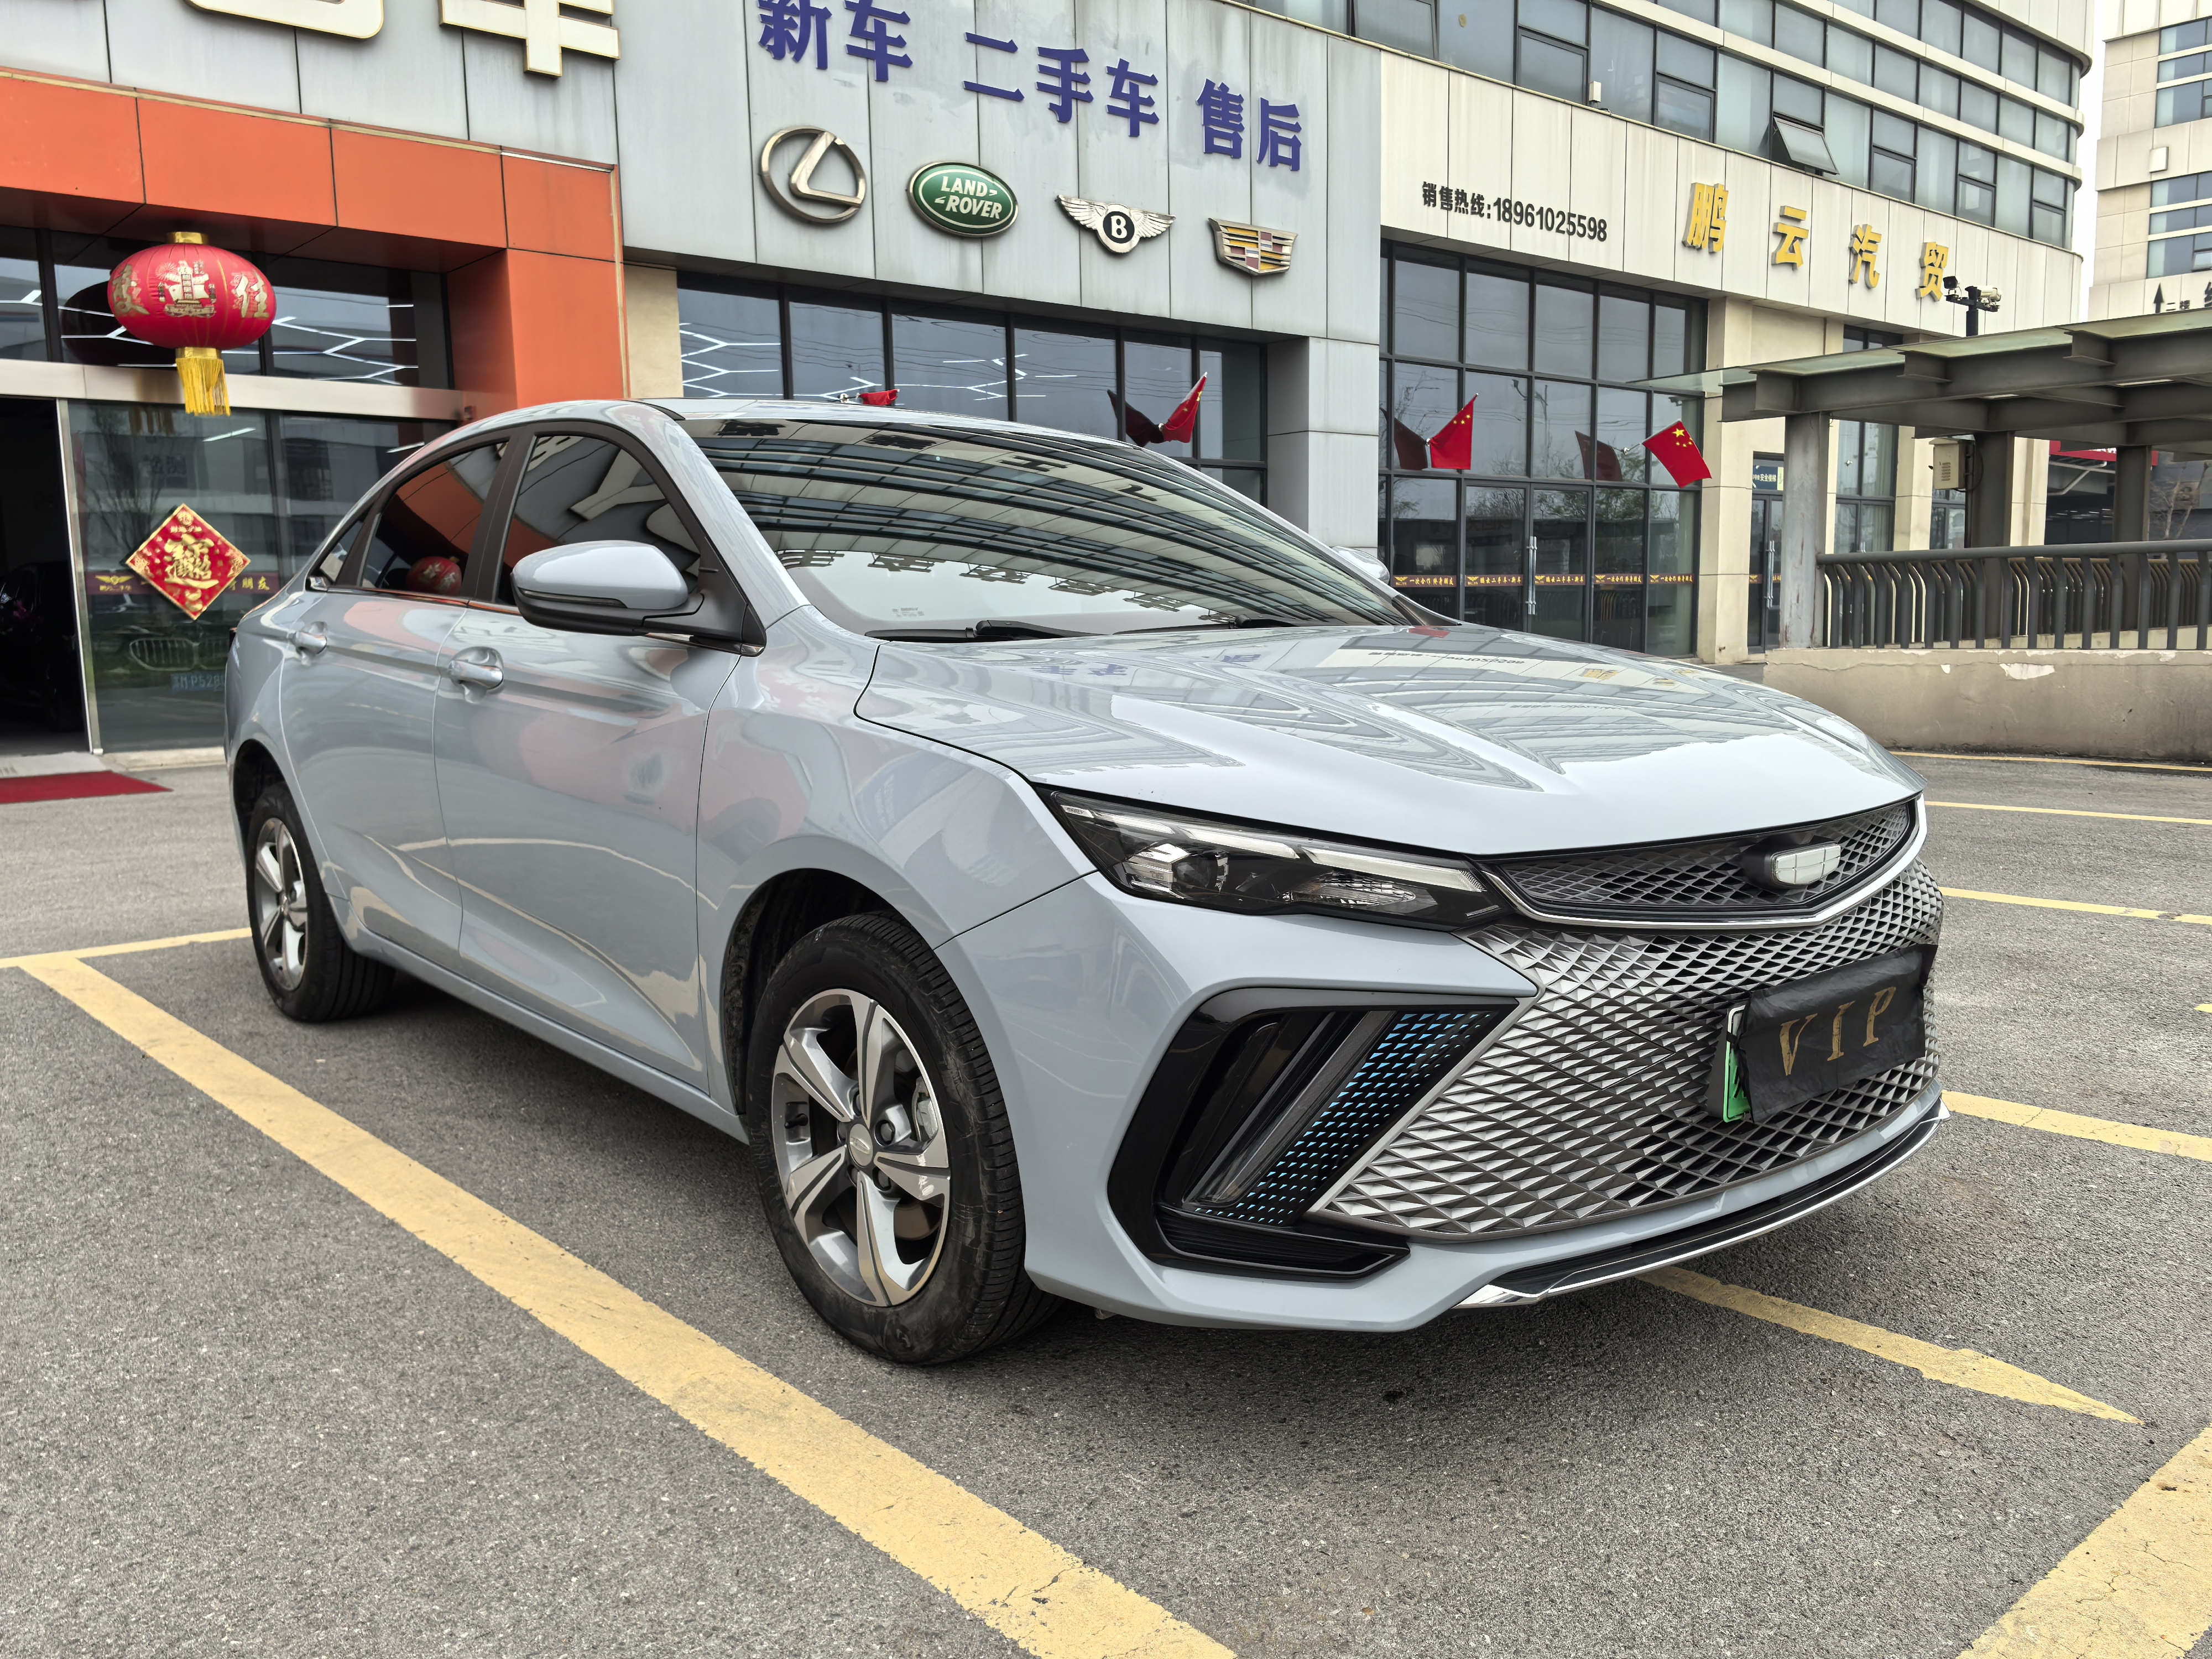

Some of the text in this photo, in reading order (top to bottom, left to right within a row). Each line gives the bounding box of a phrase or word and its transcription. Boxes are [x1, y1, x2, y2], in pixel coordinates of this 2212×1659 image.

[963, 32, 1160, 138] 二手车
[1196, 78, 1302, 171] 售后
[941, 176, 988, 197] LAND
[945, 195, 1003, 220] ROVER
[1422, 181, 1608, 242] 销售热线:18961025598
[1110, 215, 1128, 239] B
[1682, 182, 1949, 302] 鹏云汽贸
[1778, 986, 1896, 1076] VIP
